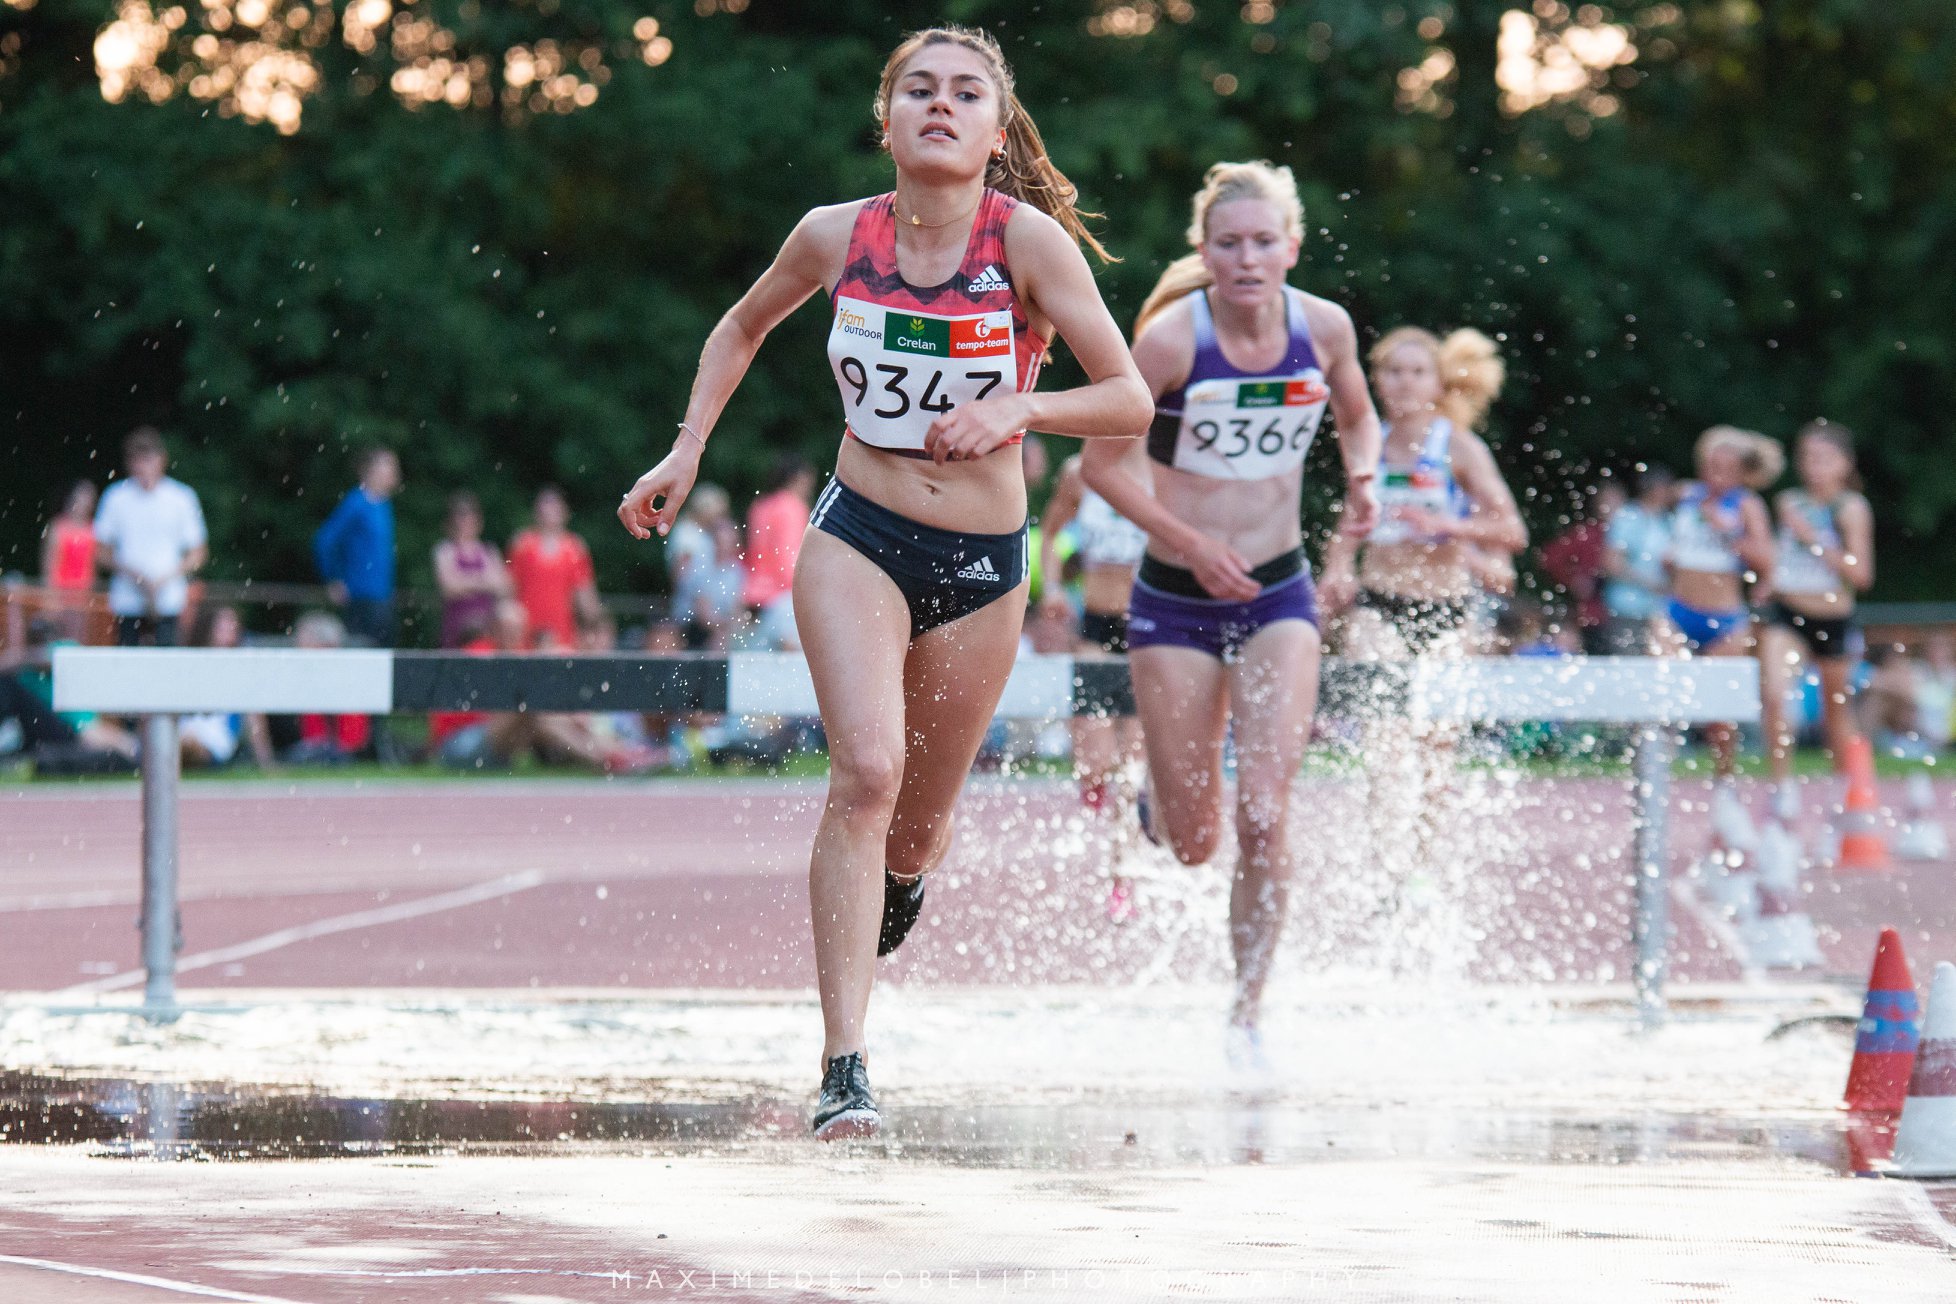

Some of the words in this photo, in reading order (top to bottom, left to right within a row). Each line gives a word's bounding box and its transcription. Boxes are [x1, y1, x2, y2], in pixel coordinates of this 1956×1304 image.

[968, 281, 1009, 292] adidas
[844, 325, 882, 340] OUTDOOR
[897, 336, 936, 351] Crelan
[956, 339, 1009, 351] tempo-team
[840, 356, 1002, 419] 9347
[1192, 415, 1312, 457] 9366
[957, 570, 1000, 582] adidas
